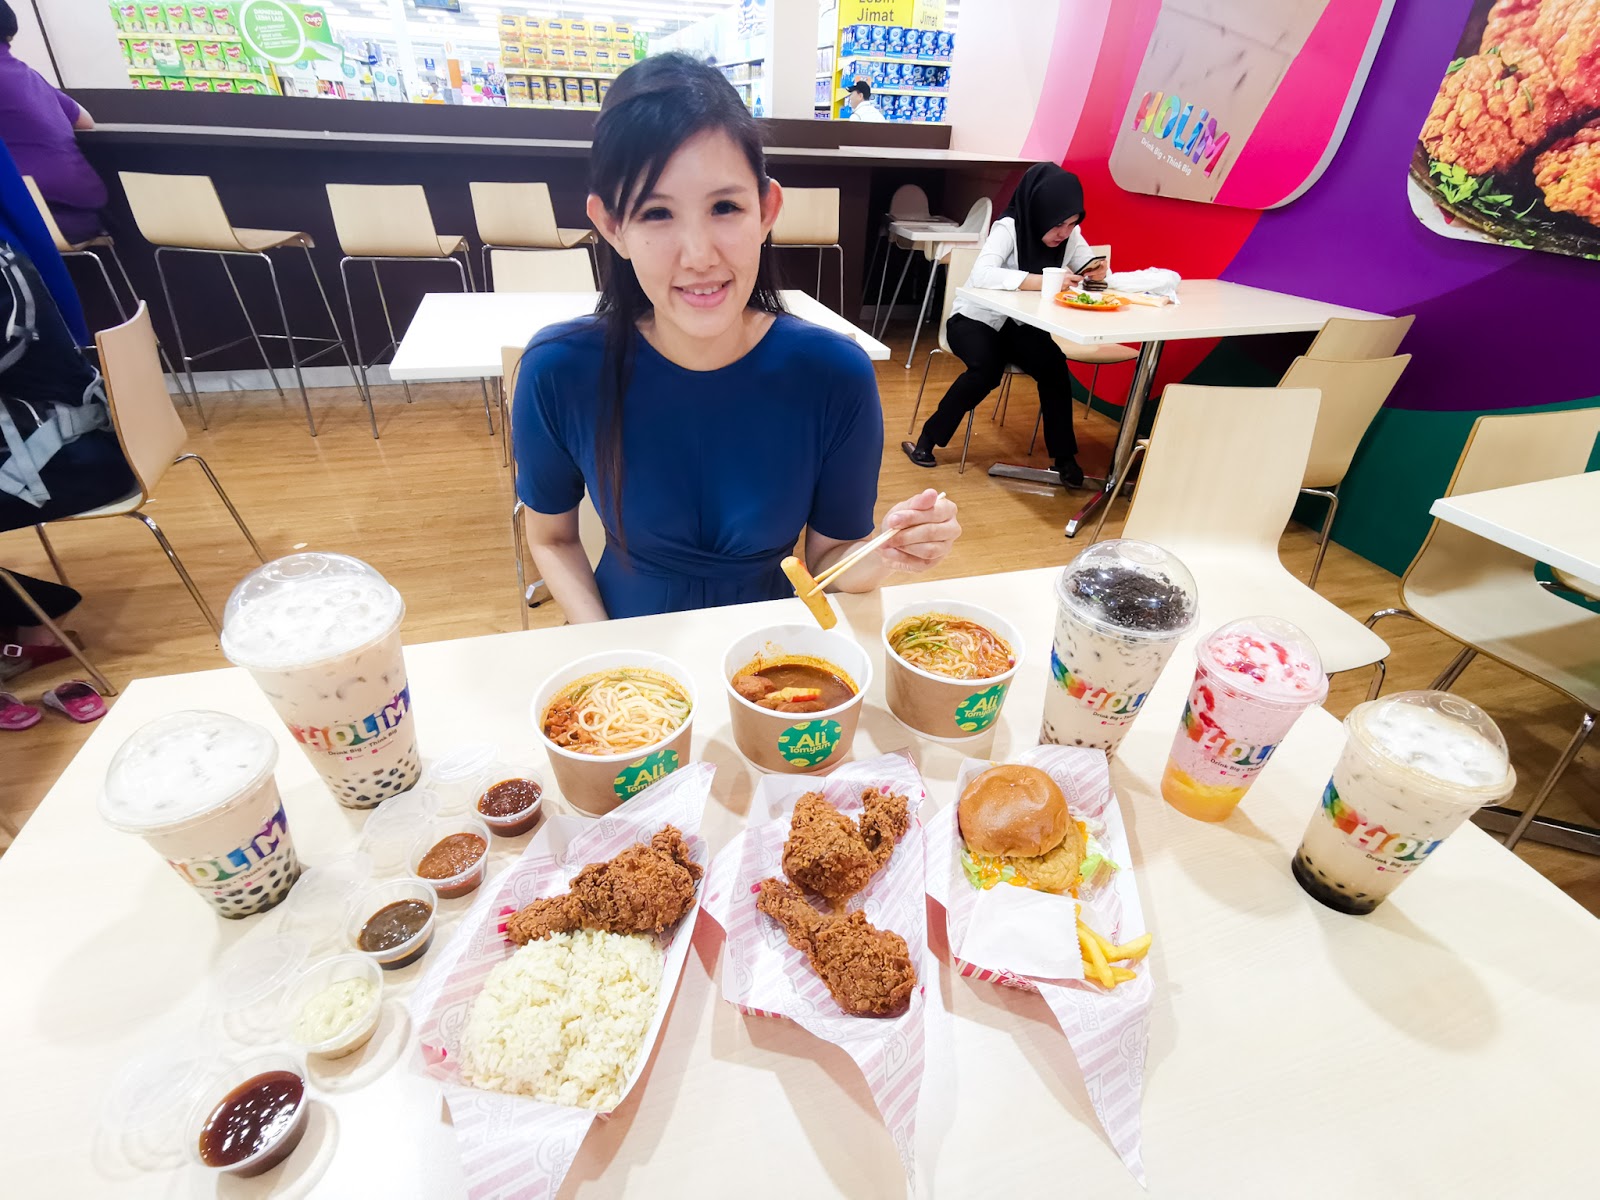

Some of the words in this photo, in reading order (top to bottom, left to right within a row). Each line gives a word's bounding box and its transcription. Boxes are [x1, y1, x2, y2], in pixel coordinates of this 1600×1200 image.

[304, 14, 323, 24] Dugro
[856, 8, 895, 22] Jimat
[1140, 137, 1155, 153] Drink
[1153, 147, 1164, 160] Big
[1166, 155, 1183, 170] Think
[1181, 164, 1193, 176] Big
[972, 692, 999, 712] Ali
[369, 736, 388, 747] Think
[388, 728, 398, 737] Big
[796, 729, 828, 748] Ali
[788, 741, 831, 755] Tomyam
[1210, 759, 1228, 769] Drink
[633, 759, 666, 787] Ali
[1365, 853, 1387, 865] Drink
